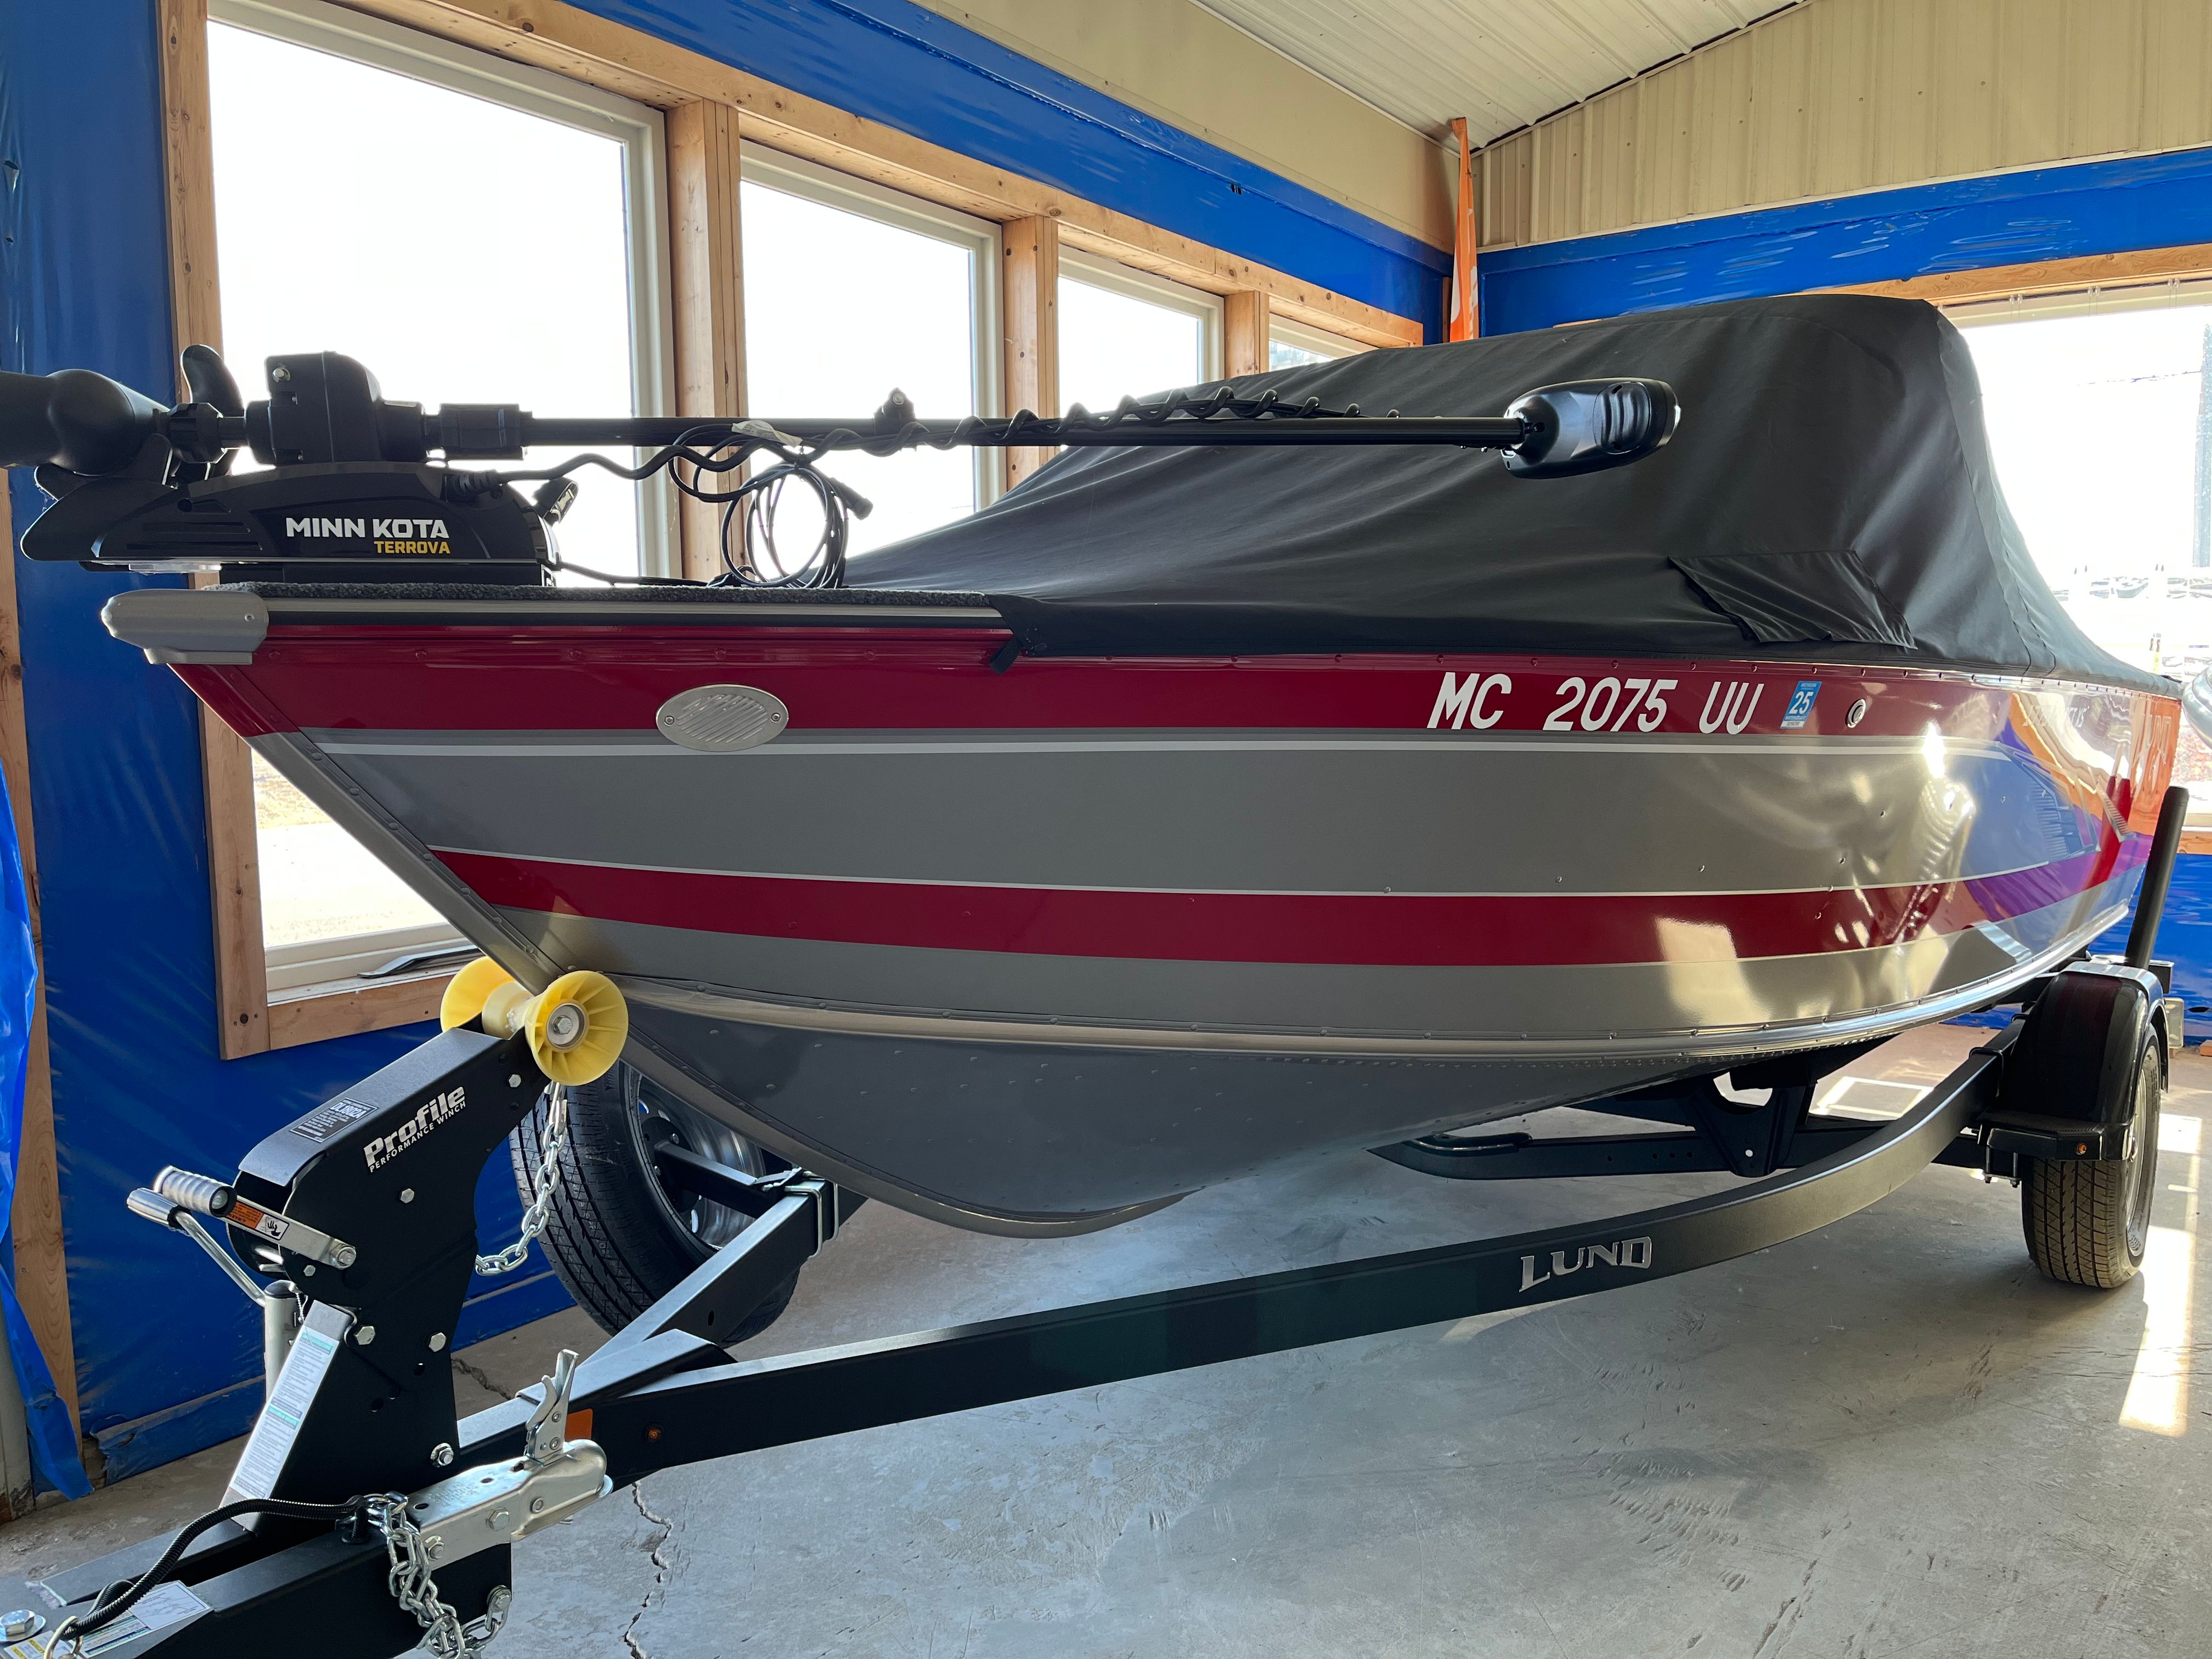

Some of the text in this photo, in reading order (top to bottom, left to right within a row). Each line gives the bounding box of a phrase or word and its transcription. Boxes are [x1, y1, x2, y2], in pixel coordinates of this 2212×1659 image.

[286, 518, 450, 539] MINN KOTA
[374, 541, 450, 554] TERROVA
[1426, 672, 1764, 735] MC 2075 UU
[1789, 691, 1814, 715] 25
[330, 1102, 367, 1119] DL1802A
[363, 1086, 466, 1167] Profile
[369, 1122, 435, 1173] PERFORMANCE
[437, 1101, 466, 1125] WINCH
[1519, 1236, 1652, 1293] LUND
